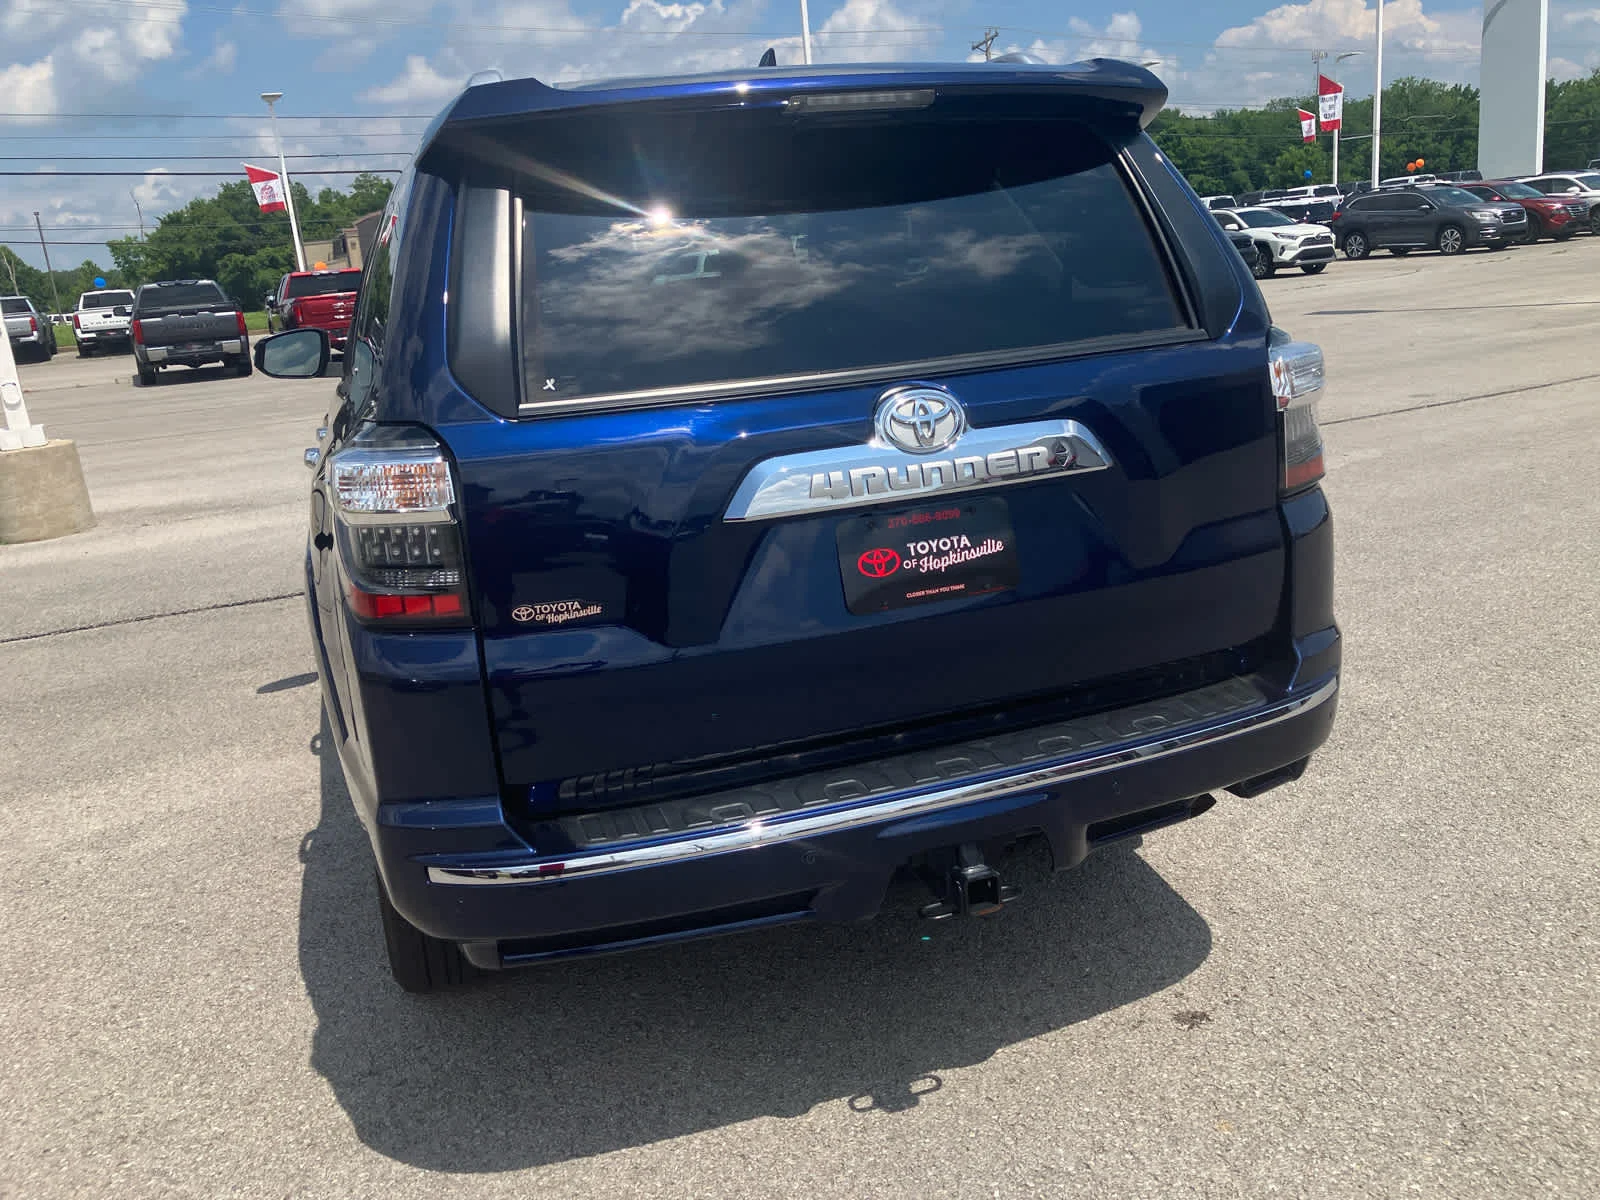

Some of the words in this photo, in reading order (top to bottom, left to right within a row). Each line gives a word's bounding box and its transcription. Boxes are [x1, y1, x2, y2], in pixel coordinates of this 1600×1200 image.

[809, 446, 1051, 500] 4RUNNER
[903, 559, 918, 569] OF
[919, 538, 1004, 573] Hopkinsville
[906, 534, 971, 556] TOYOTA
[534, 601, 581, 614] TOYOTA
[546, 605, 602, 624] Hopkinsville
